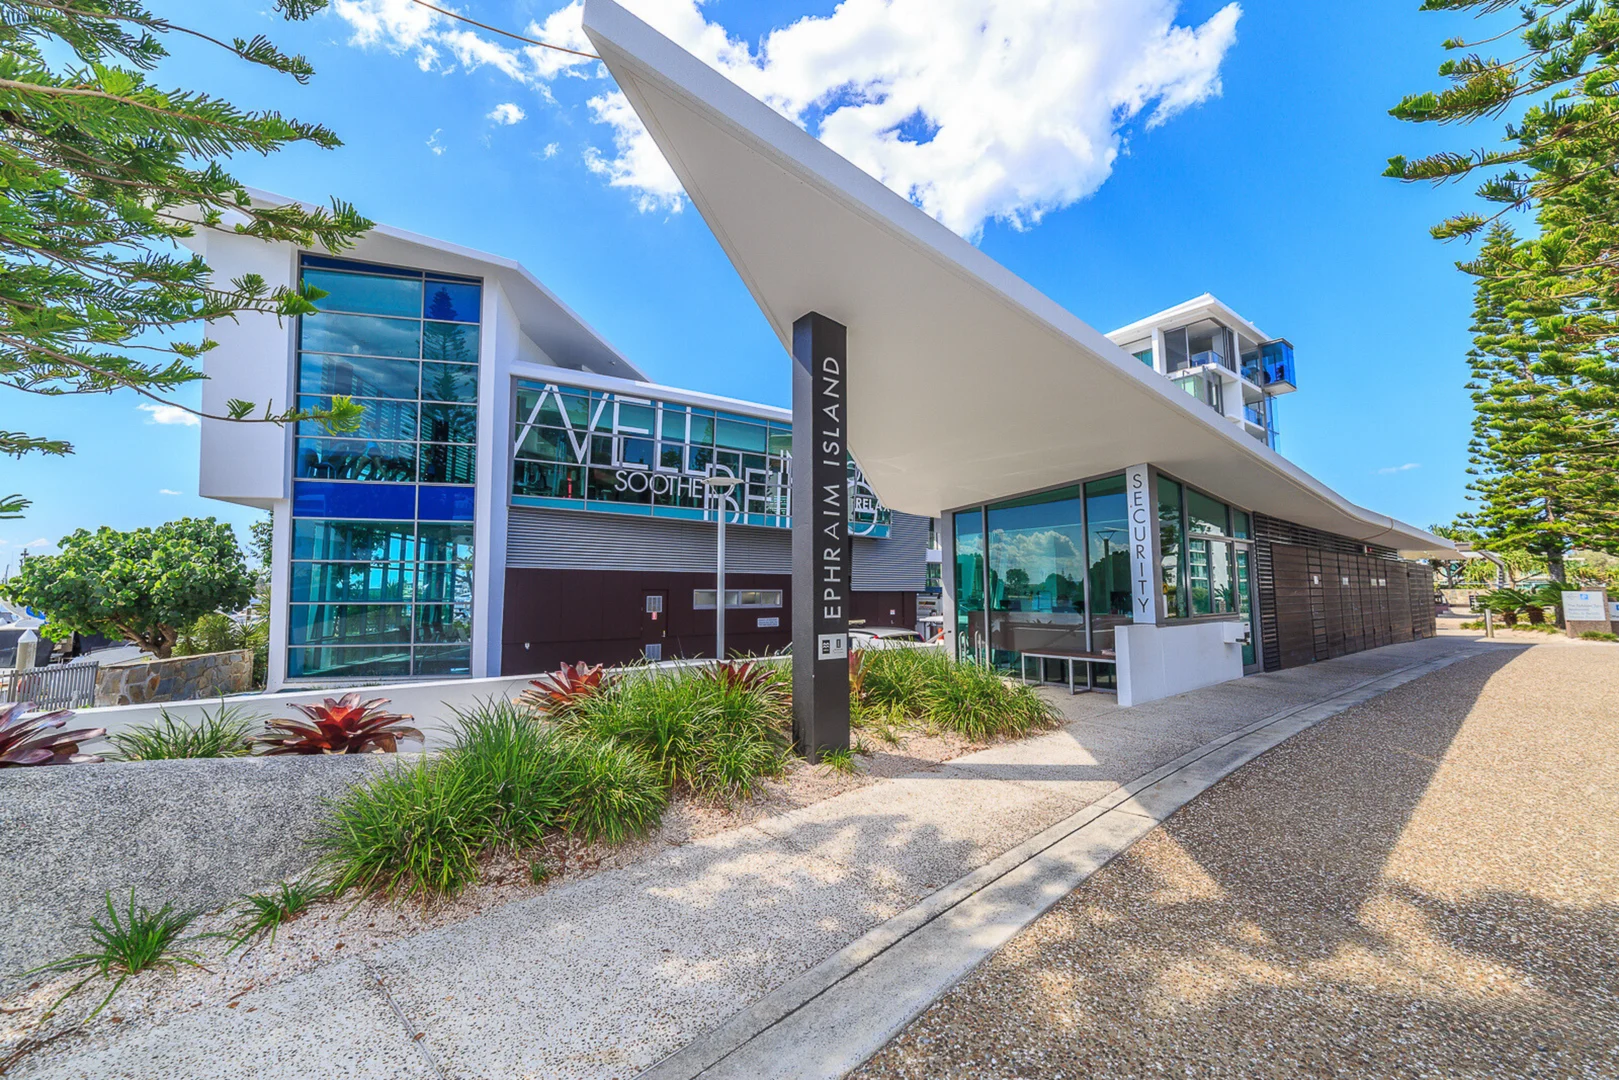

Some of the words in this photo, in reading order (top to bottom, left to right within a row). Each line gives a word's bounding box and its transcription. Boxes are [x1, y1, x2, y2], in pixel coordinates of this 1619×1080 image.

[514, 383, 709, 476] WELL
[822, 356, 840, 467] ISLAND
[614, 470, 703, 498] SOOTHE
[822, 484, 842, 619] EPHRAIM
[1132, 473, 1150, 613] SECURITY
